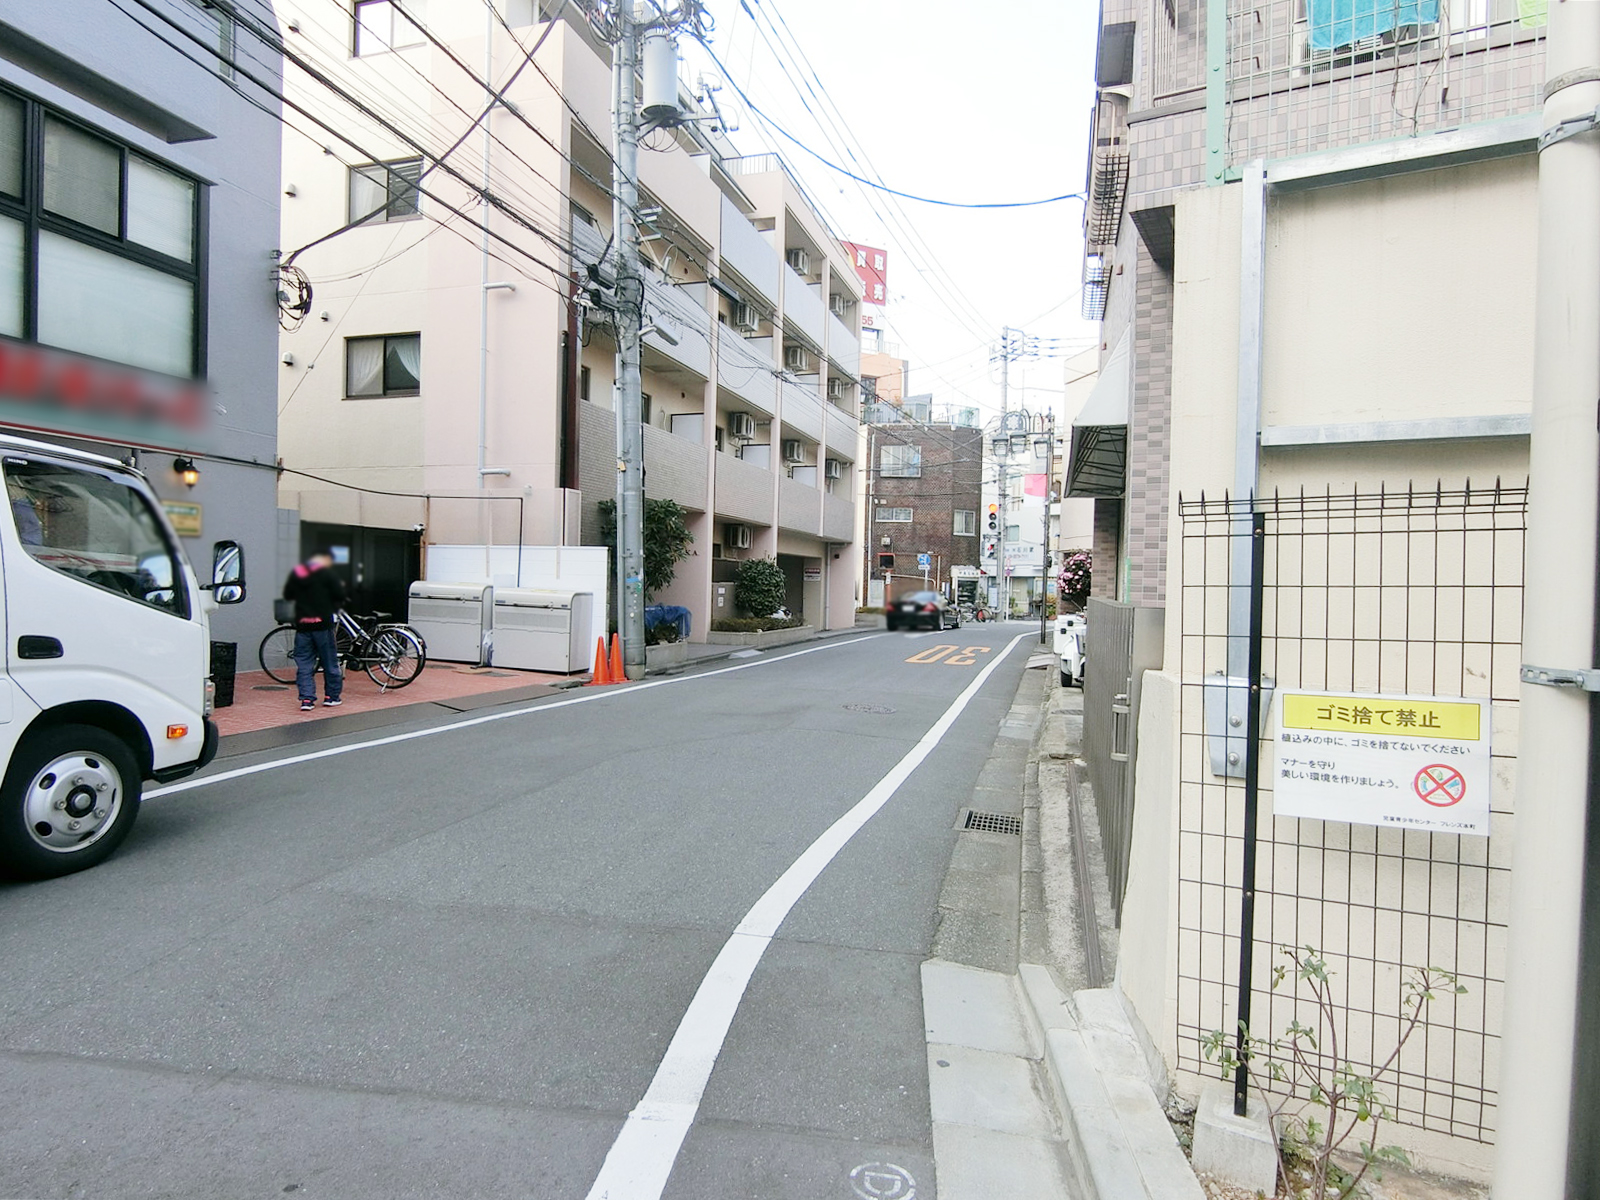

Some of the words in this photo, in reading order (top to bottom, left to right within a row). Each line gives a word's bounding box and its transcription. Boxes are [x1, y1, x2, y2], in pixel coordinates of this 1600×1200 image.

[1316, 704, 1441, 729] ゴミ捨て禁止
[1281, 732, 1471, 755] 植込みの中に、ゴミを捨てないでください
[1280, 758, 1336, 770] マナーを守り
[1280, 769, 1399, 789] 美しい環境を作りましょう。
